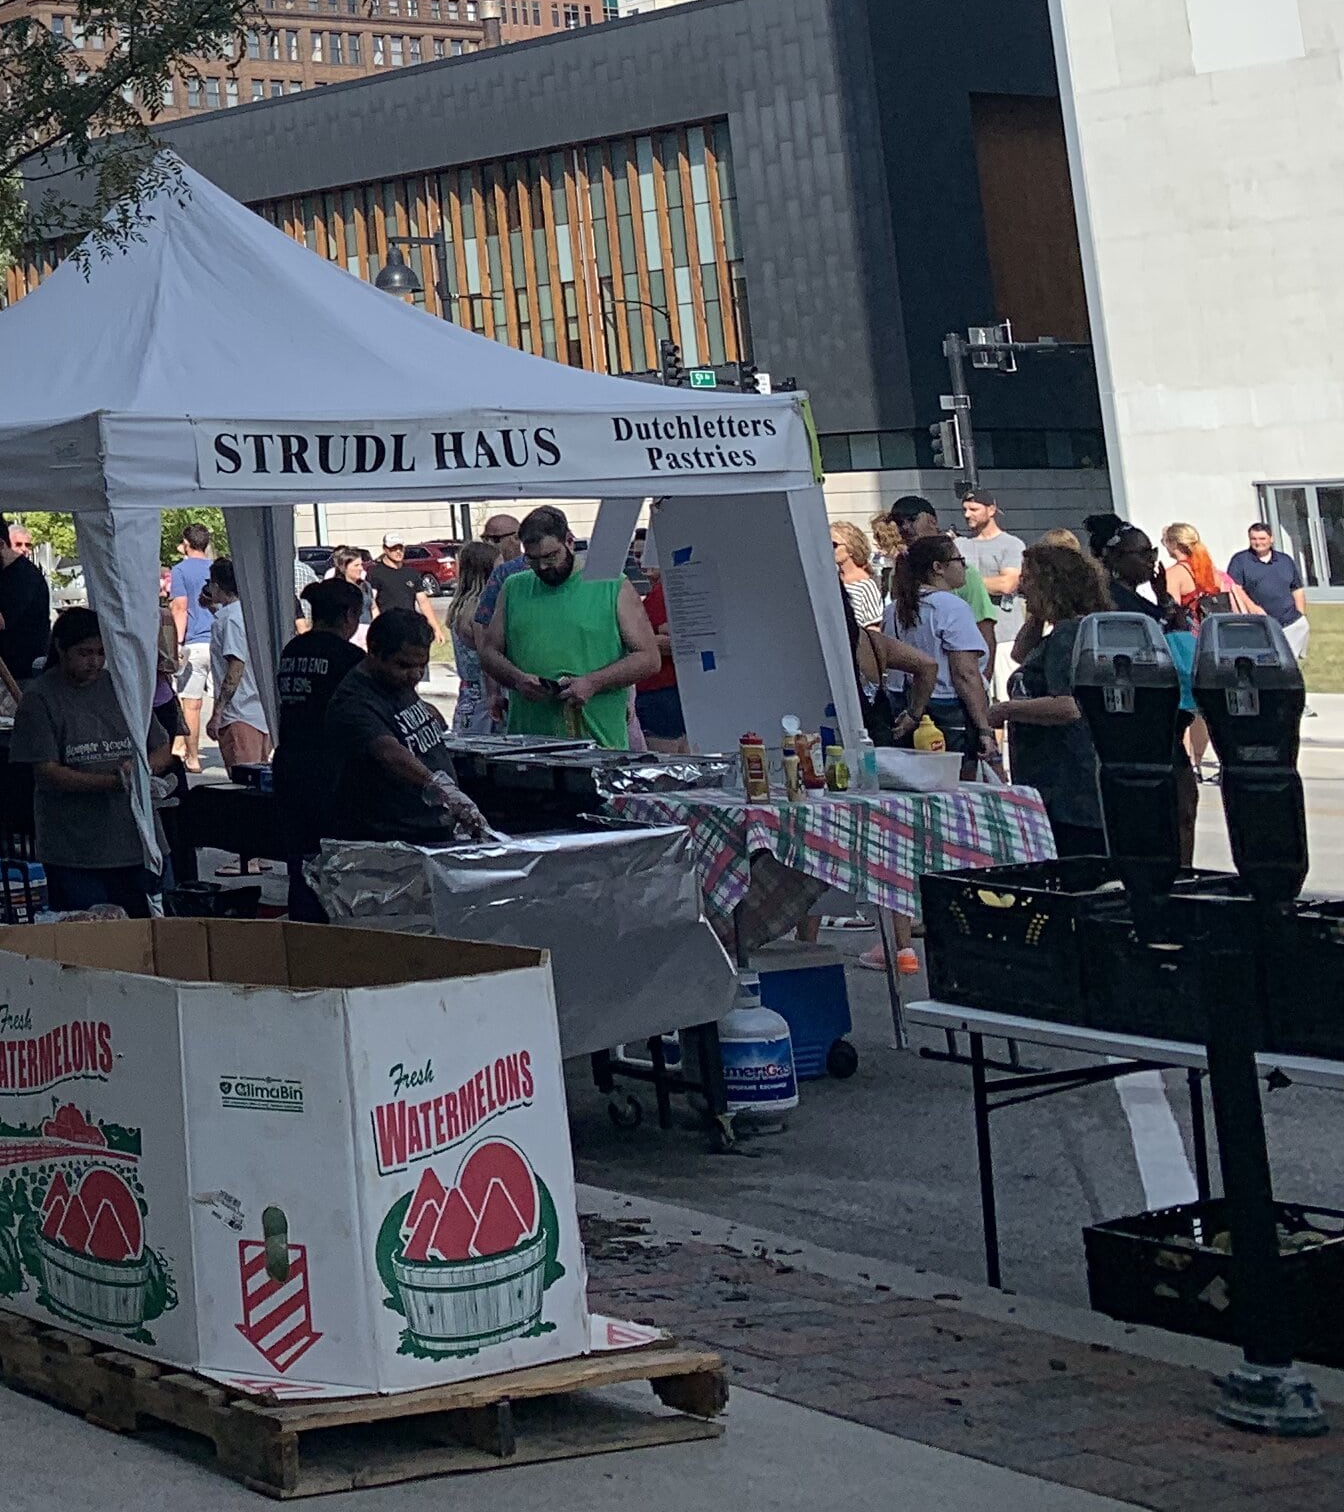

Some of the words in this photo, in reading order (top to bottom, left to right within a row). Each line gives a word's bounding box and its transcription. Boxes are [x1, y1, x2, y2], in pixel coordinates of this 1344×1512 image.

[611, 414, 777, 442] Dutchletters
[213, 432, 416, 475] STRUDL
[430, 426, 562, 471] HAUS
[645, 444, 757, 471] Pastries
[389, 1058, 435, 1097] Fresh
[723, 1063, 792, 1078] meriGas
[375, 1049, 534, 1168] WATERMELONS
